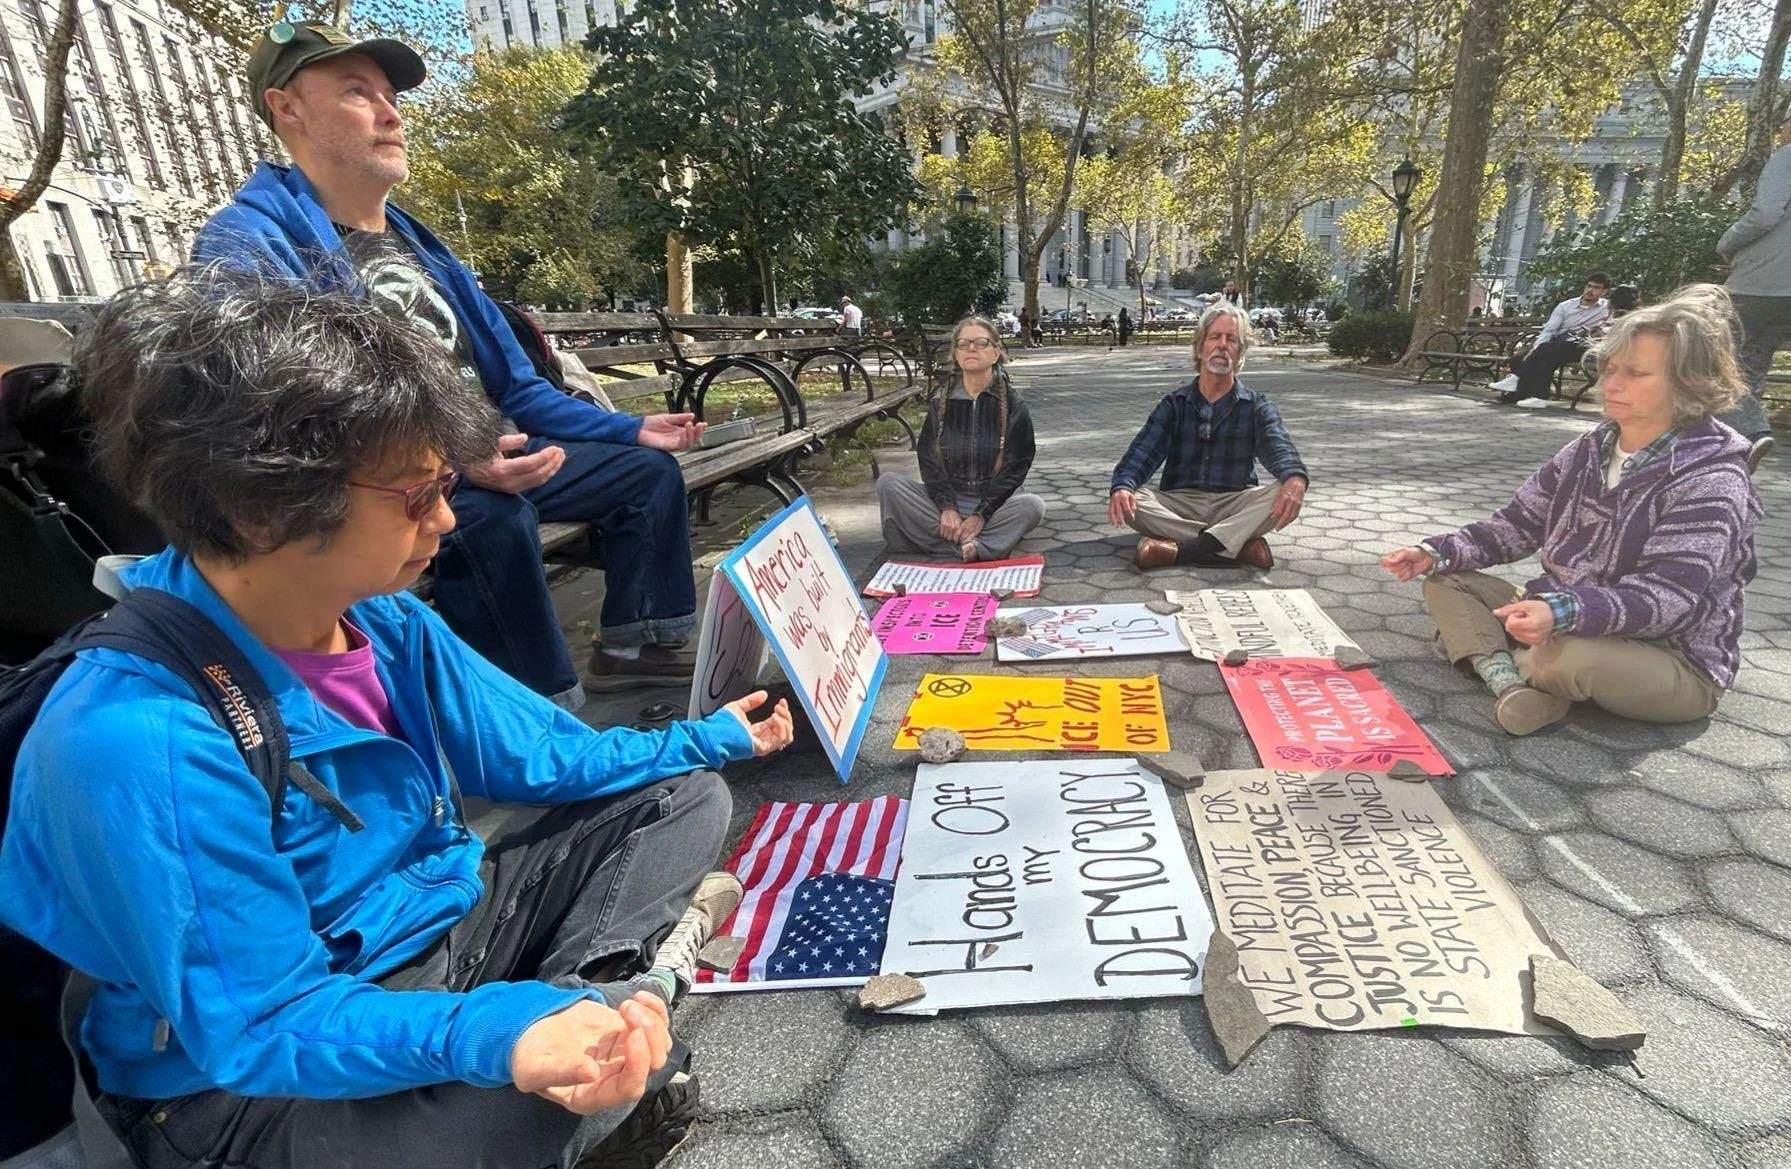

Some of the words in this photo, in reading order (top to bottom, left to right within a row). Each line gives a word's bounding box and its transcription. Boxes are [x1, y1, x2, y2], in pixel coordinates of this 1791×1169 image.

[743, 530, 813, 624] America
[782, 606, 814, 651] was
[798, 560, 833, 614] built
[904, 613, 927, 627] INTO
[929, 613, 961, 628] ICE
[1211, 590, 1260, 618] REBELS
[814, 624, 836, 653] by
[1077, 625, 1114, 634] R
[1111, 618, 1170, 641] US
[813, 597, 874, 744] Immigrants
[1255, 678, 1276, 692] THE
[227, 685, 264, 745] Riviera
[1062, 678, 1102, 713] OUT
[1119, 683, 1158, 715] NYC
[1264, 692, 1308, 742] PROTECTING
[1280, 677, 1356, 743] PLANET
[1324, 677, 1384, 725] SACRED
[221, 696, 254, 751] PARTNERS
[1061, 720, 1101, 752] ICE
[1125, 723, 1158, 745] OF
[1360, 726, 1398, 740] IS
[1200, 789, 1242, 824] FOR
[1239, 780, 1270, 796] &
[1274, 769, 1320, 816] THERE
[1309, 781, 1347, 799] IN
[1244, 802, 1303, 865] PEACE
[1345, 771, 1438, 888] SANCTIONED
[1059, 770, 1199, 988] DEMOCRACY
[1294, 822, 1361, 899] BECAUSE
[1401, 809, 1497, 912] VIOLENCE
[904, 853, 1034, 979] Hands
[1209, 841, 1289, 952] MEDITATE
[1268, 867, 1366, 1027] COMPASSION,
[1395, 940, 1447, 978] NO
[1409, 893, 1491, 980] STATE
[1330, 910, 1419, 1016] JUSTICE
[1241, 964, 1305, 1018] WE
[1418, 989, 1470, 1015] IS
